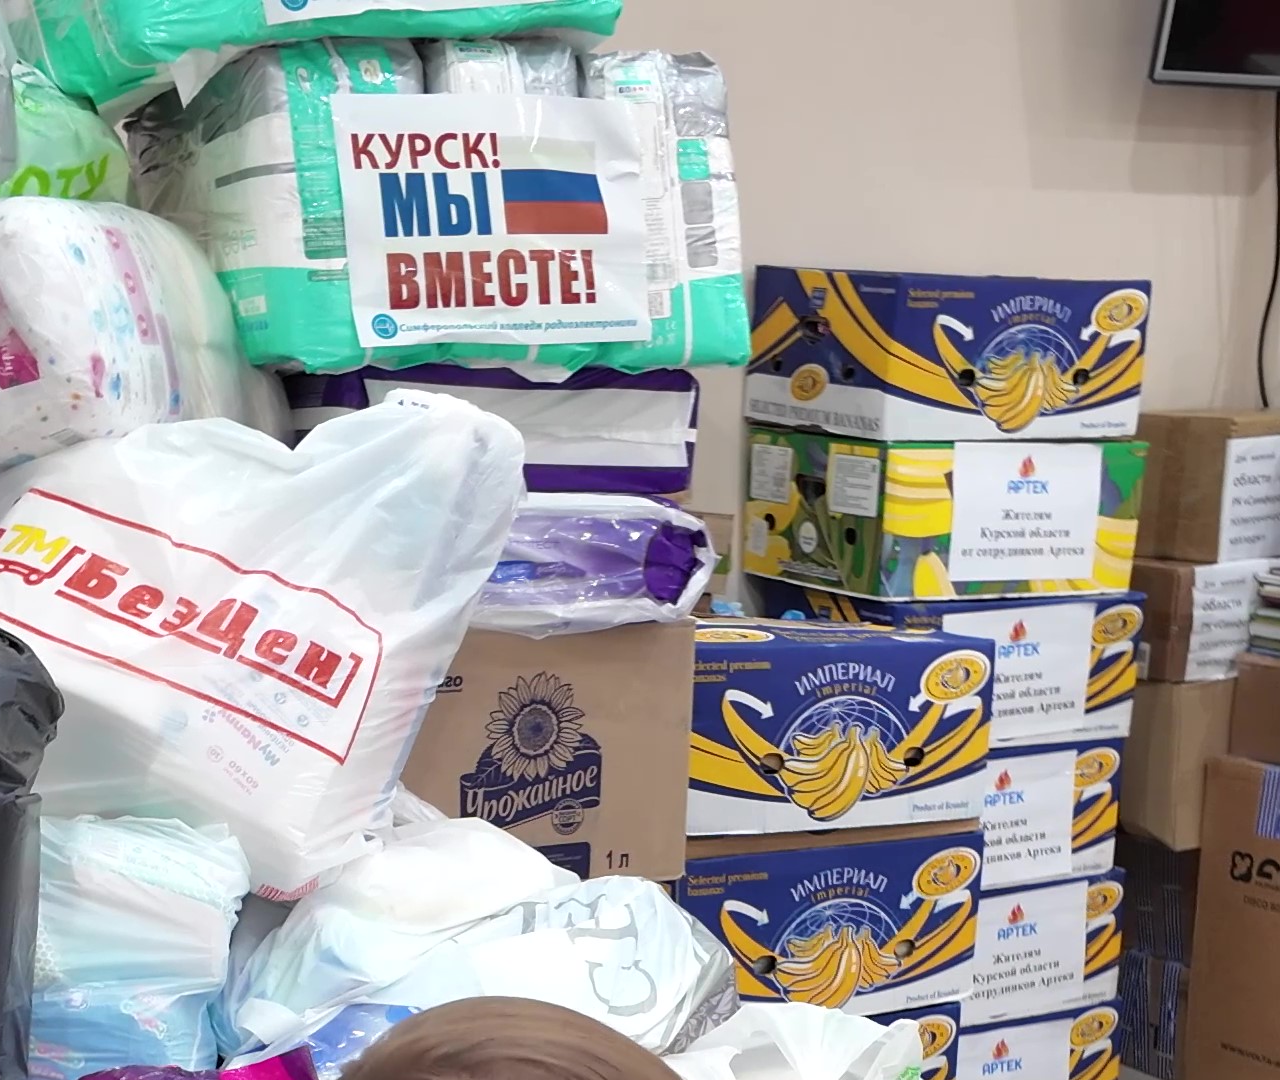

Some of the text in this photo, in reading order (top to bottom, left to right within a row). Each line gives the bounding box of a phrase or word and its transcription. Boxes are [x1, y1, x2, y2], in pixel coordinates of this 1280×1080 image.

[350, 132, 501, 170] КУРСК!
[378, 172, 493, 237] МЫ
[386, 248, 598, 311] ВМЕСТЕ!
[991, 295, 1073, 323] ИМПЕРИАЛ
[787, 403, 832, 427] PREMIUM
[833, 408, 881, 433] BANANAS
[1006, 479, 1050, 495] АРТЕК
[1001, 508, 1053, 521] Жителям
[980, 526, 1071, 541] Курской области
[998, 642, 1041, 659] АРТЕК
[794, 661, 896, 696] ИМПЕРИАЛ
[816, 681, 877, 698] imperial
[1018, 686, 1062, 699] области
[217, 708, 281, 767] MyNanny
[466, 765, 599, 823] Урожайное
[984, 790, 1025, 808] АРТЕК
[912, 802, 937, 813] Product
[938, 802, 945, 810] of
[1005, 832, 1047, 845] области
[606, 850, 629, 870] 1 л
[1026, 845, 1062, 861] Артека
[687, 871, 769, 886] Selected premium
[790, 866, 888, 902] ИМПЕРИАЛ
[687, 885, 726, 897] bananas
[811, 886, 870, 904] imperial
[997, 922, 1038, 941] АРТЕК
[992, 948, 1042, 965] Жителям
[972, 960, 1060, 985] Курской области
[1038, 973, 1075, 988] Артека
[906, 993, 929, 1003] Product
[982, 1058, 1023, 1076] АРТЕК
